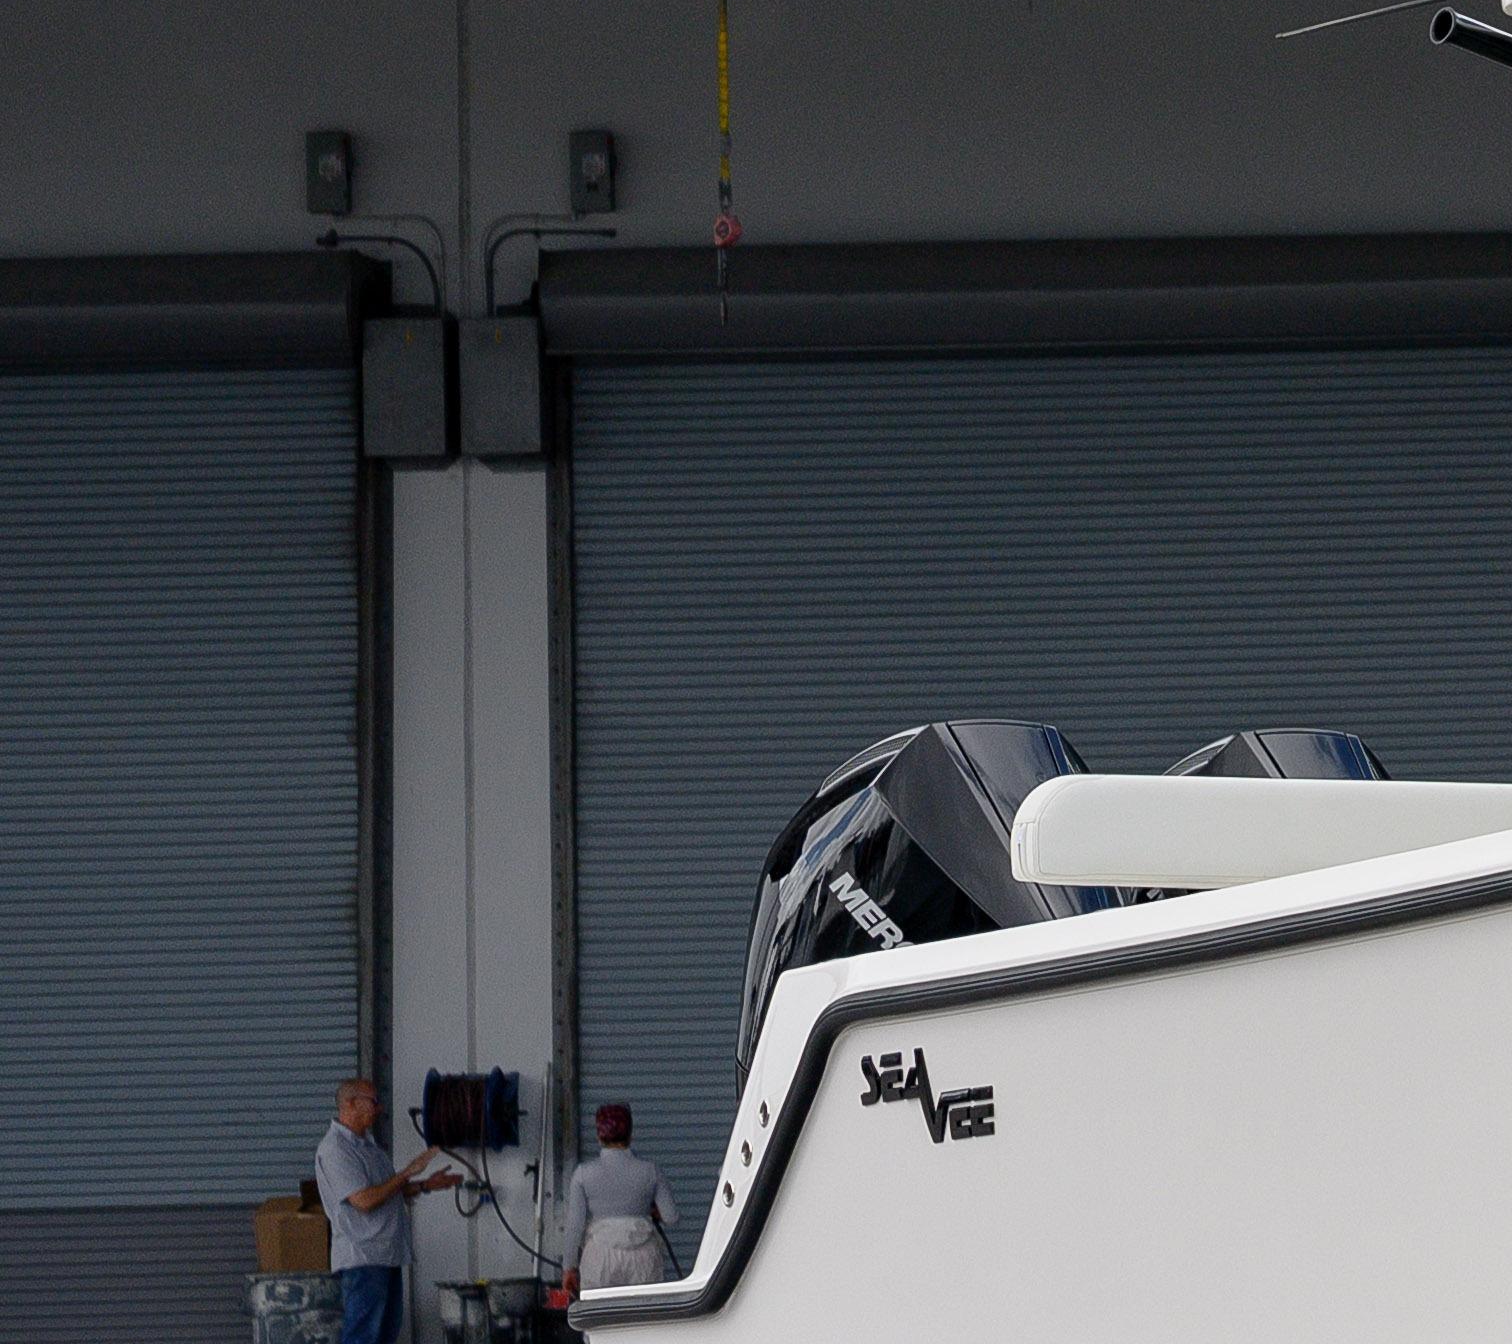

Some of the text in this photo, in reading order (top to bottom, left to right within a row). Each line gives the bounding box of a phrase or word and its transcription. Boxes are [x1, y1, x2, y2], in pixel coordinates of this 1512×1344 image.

[828, 871, 914, 950] MER
[860, 1047, 928, 1107] SEA
[920, 1085, 996, 1144] VEE
